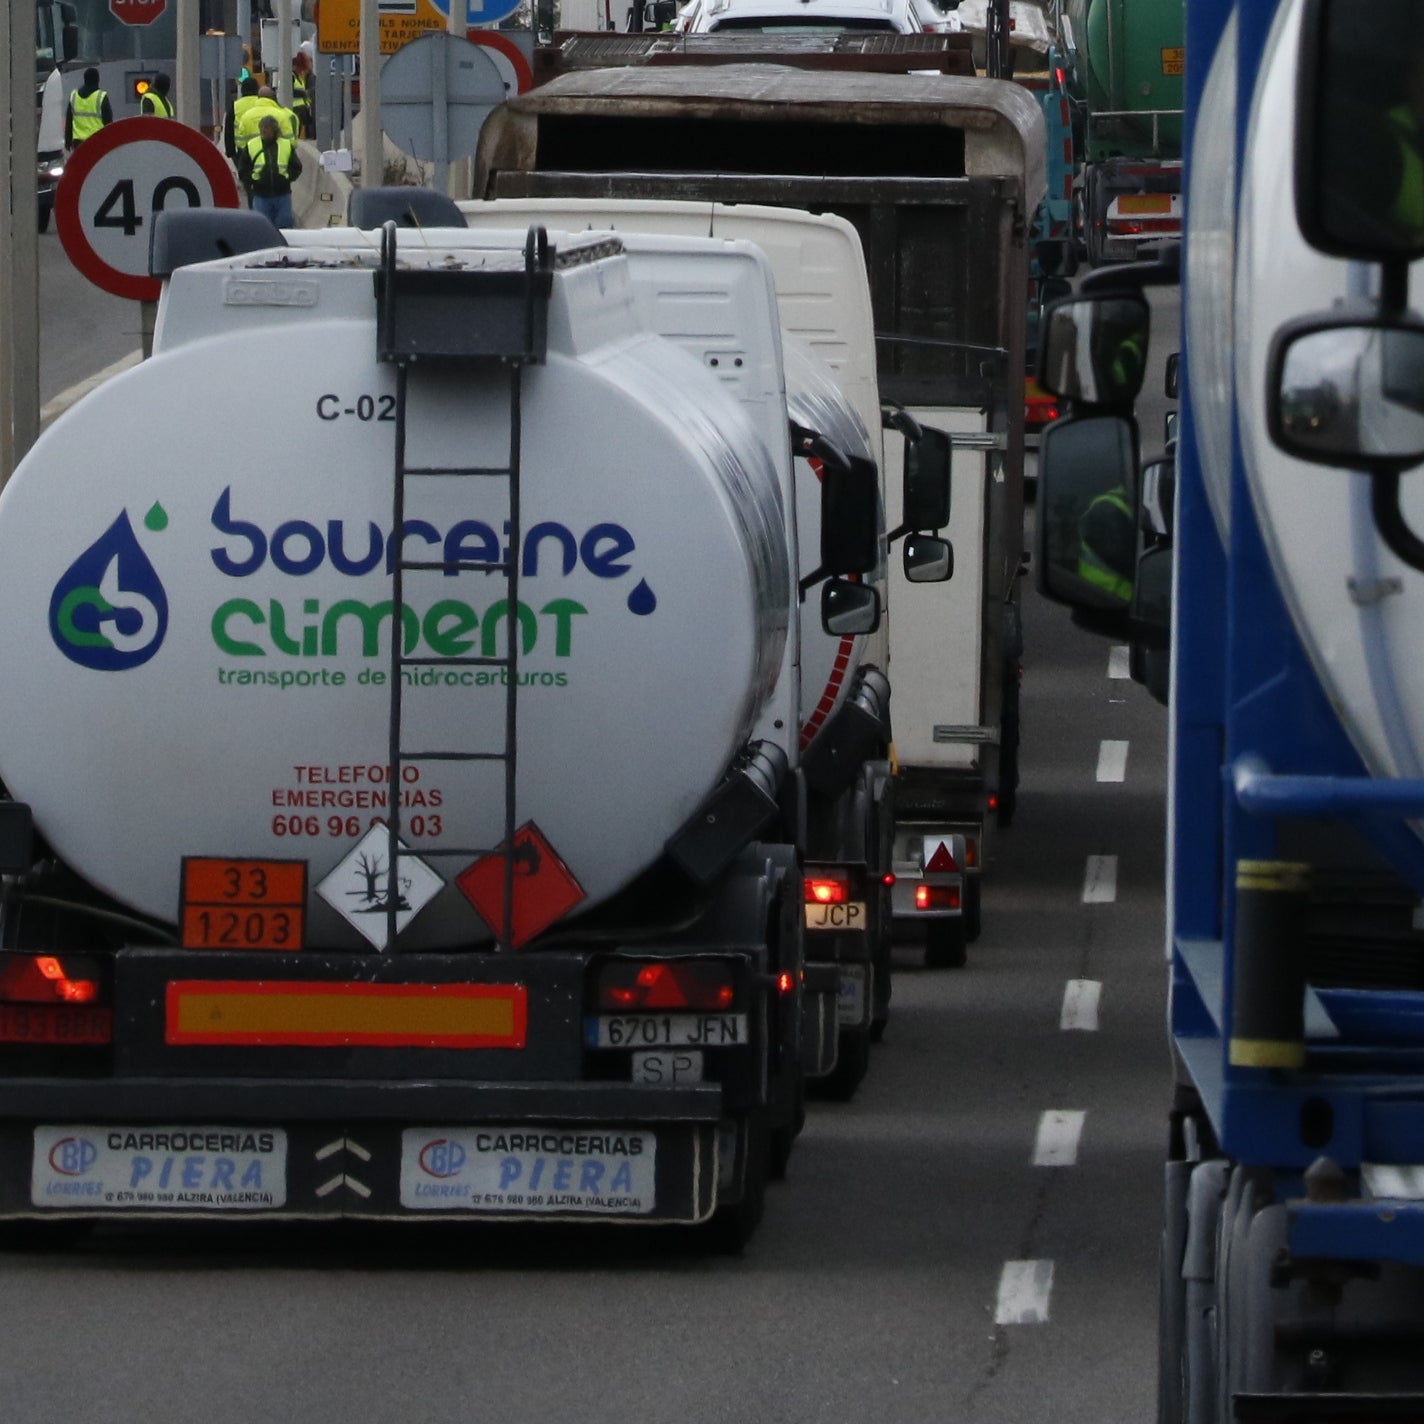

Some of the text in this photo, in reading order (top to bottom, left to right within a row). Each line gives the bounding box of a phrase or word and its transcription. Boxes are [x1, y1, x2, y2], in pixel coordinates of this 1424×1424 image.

[93, 176, 201, 236] 40
[316, 393, 396, 422] C-02
[217, 666, 345, 690] transporte
[356, 666, 386, 687] de
[271, 814, 321, 837] 606
[327, 815, 361, 837] 96
[410, 814, 443, 837] 03
[223, 866, 268, 899] 33
[199, 911, 290, 944] 1203
[814, 904, 860, 926] JCP
[607, 1016, 738, 1045] 6701 JFN
[642, 1056, 692, 1084] SP
[107, 1133, 274, 1153] CARROCERIAS
[476, 1134, 643, 1156] CARROCERIAS
[129, 1156, 263, 1190] PIERA
[499, 1156, 633, 1195] PIERA
[177, 1192, 213, 1203] ALZIRA
